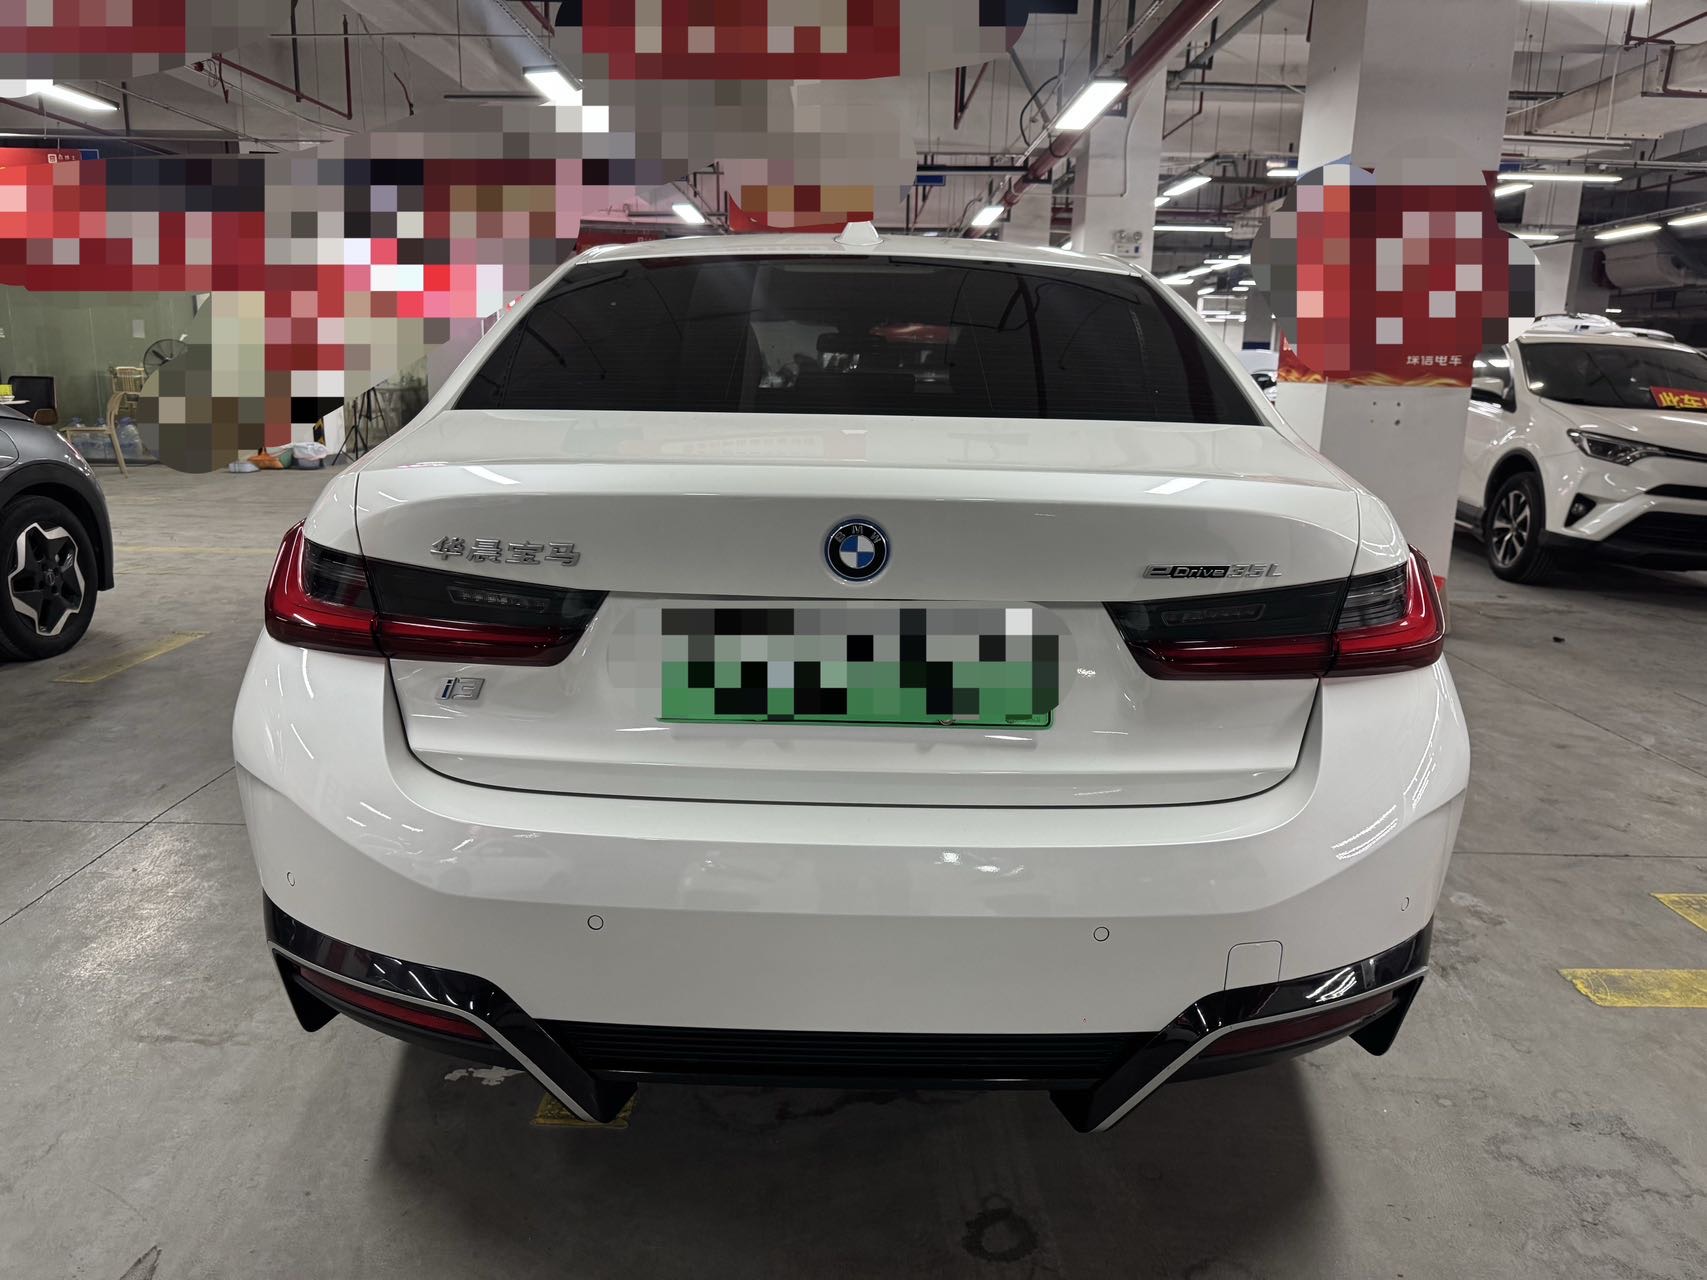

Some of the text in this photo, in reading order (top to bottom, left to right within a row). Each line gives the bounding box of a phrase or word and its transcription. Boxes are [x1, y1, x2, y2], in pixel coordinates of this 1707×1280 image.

[1658, 391, 1707, 409] 此车
[430, 535, 581, 567] 华晨宝马
[440, 677, 487, 701] i3
